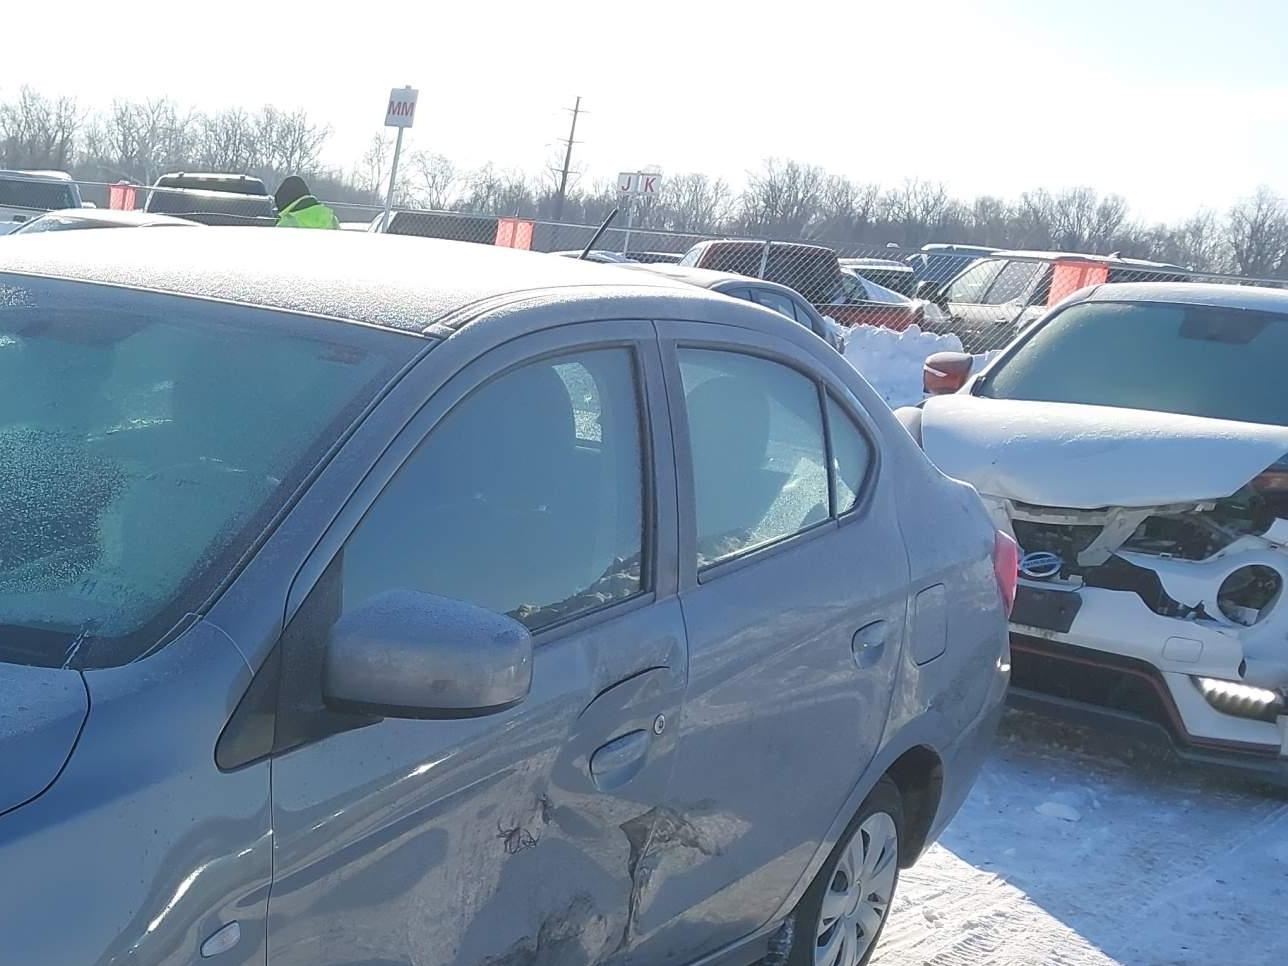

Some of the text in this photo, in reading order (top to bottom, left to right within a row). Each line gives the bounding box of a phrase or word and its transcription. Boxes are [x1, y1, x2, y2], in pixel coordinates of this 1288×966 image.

[387, 100, 415, 117] MM
[621, 175, 657, 193] J K
